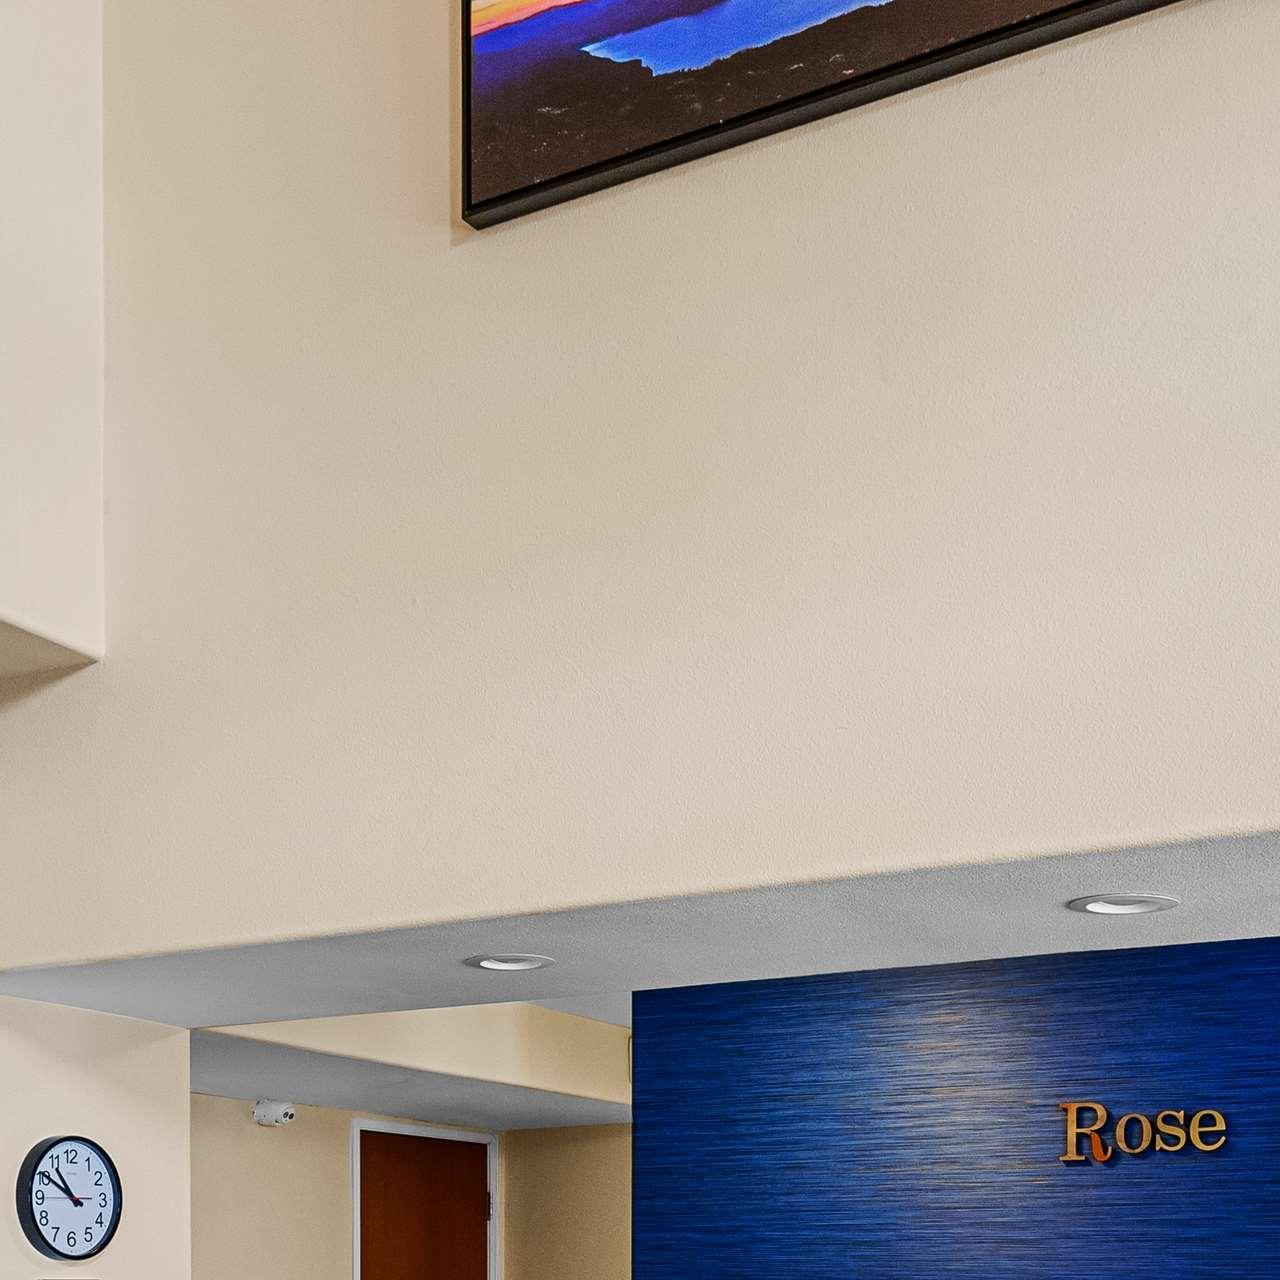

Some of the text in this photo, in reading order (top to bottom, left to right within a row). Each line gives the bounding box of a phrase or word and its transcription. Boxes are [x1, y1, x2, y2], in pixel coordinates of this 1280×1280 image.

[1060, 1101, 1228, 1165] Rose
[49, 1154, 60, 1169] 11
[64, 1149, 78, 1164] 12
[85, 1157, 91, 1172] 1
[37, 1171, 51, 1186] 10
[94, 1171, 103, 1186] 2
[35, 1190, 45, 1206] 9
[99, 1193, 107, 1208] 3
[39, 1210, 49, 1226] 8
[95, 1212, 104, 1227] 4
[51, 1227, 60, 1242] 7
[67, 1231, 77, 1247] 6
[84, 1227, 93, 1243] 5
